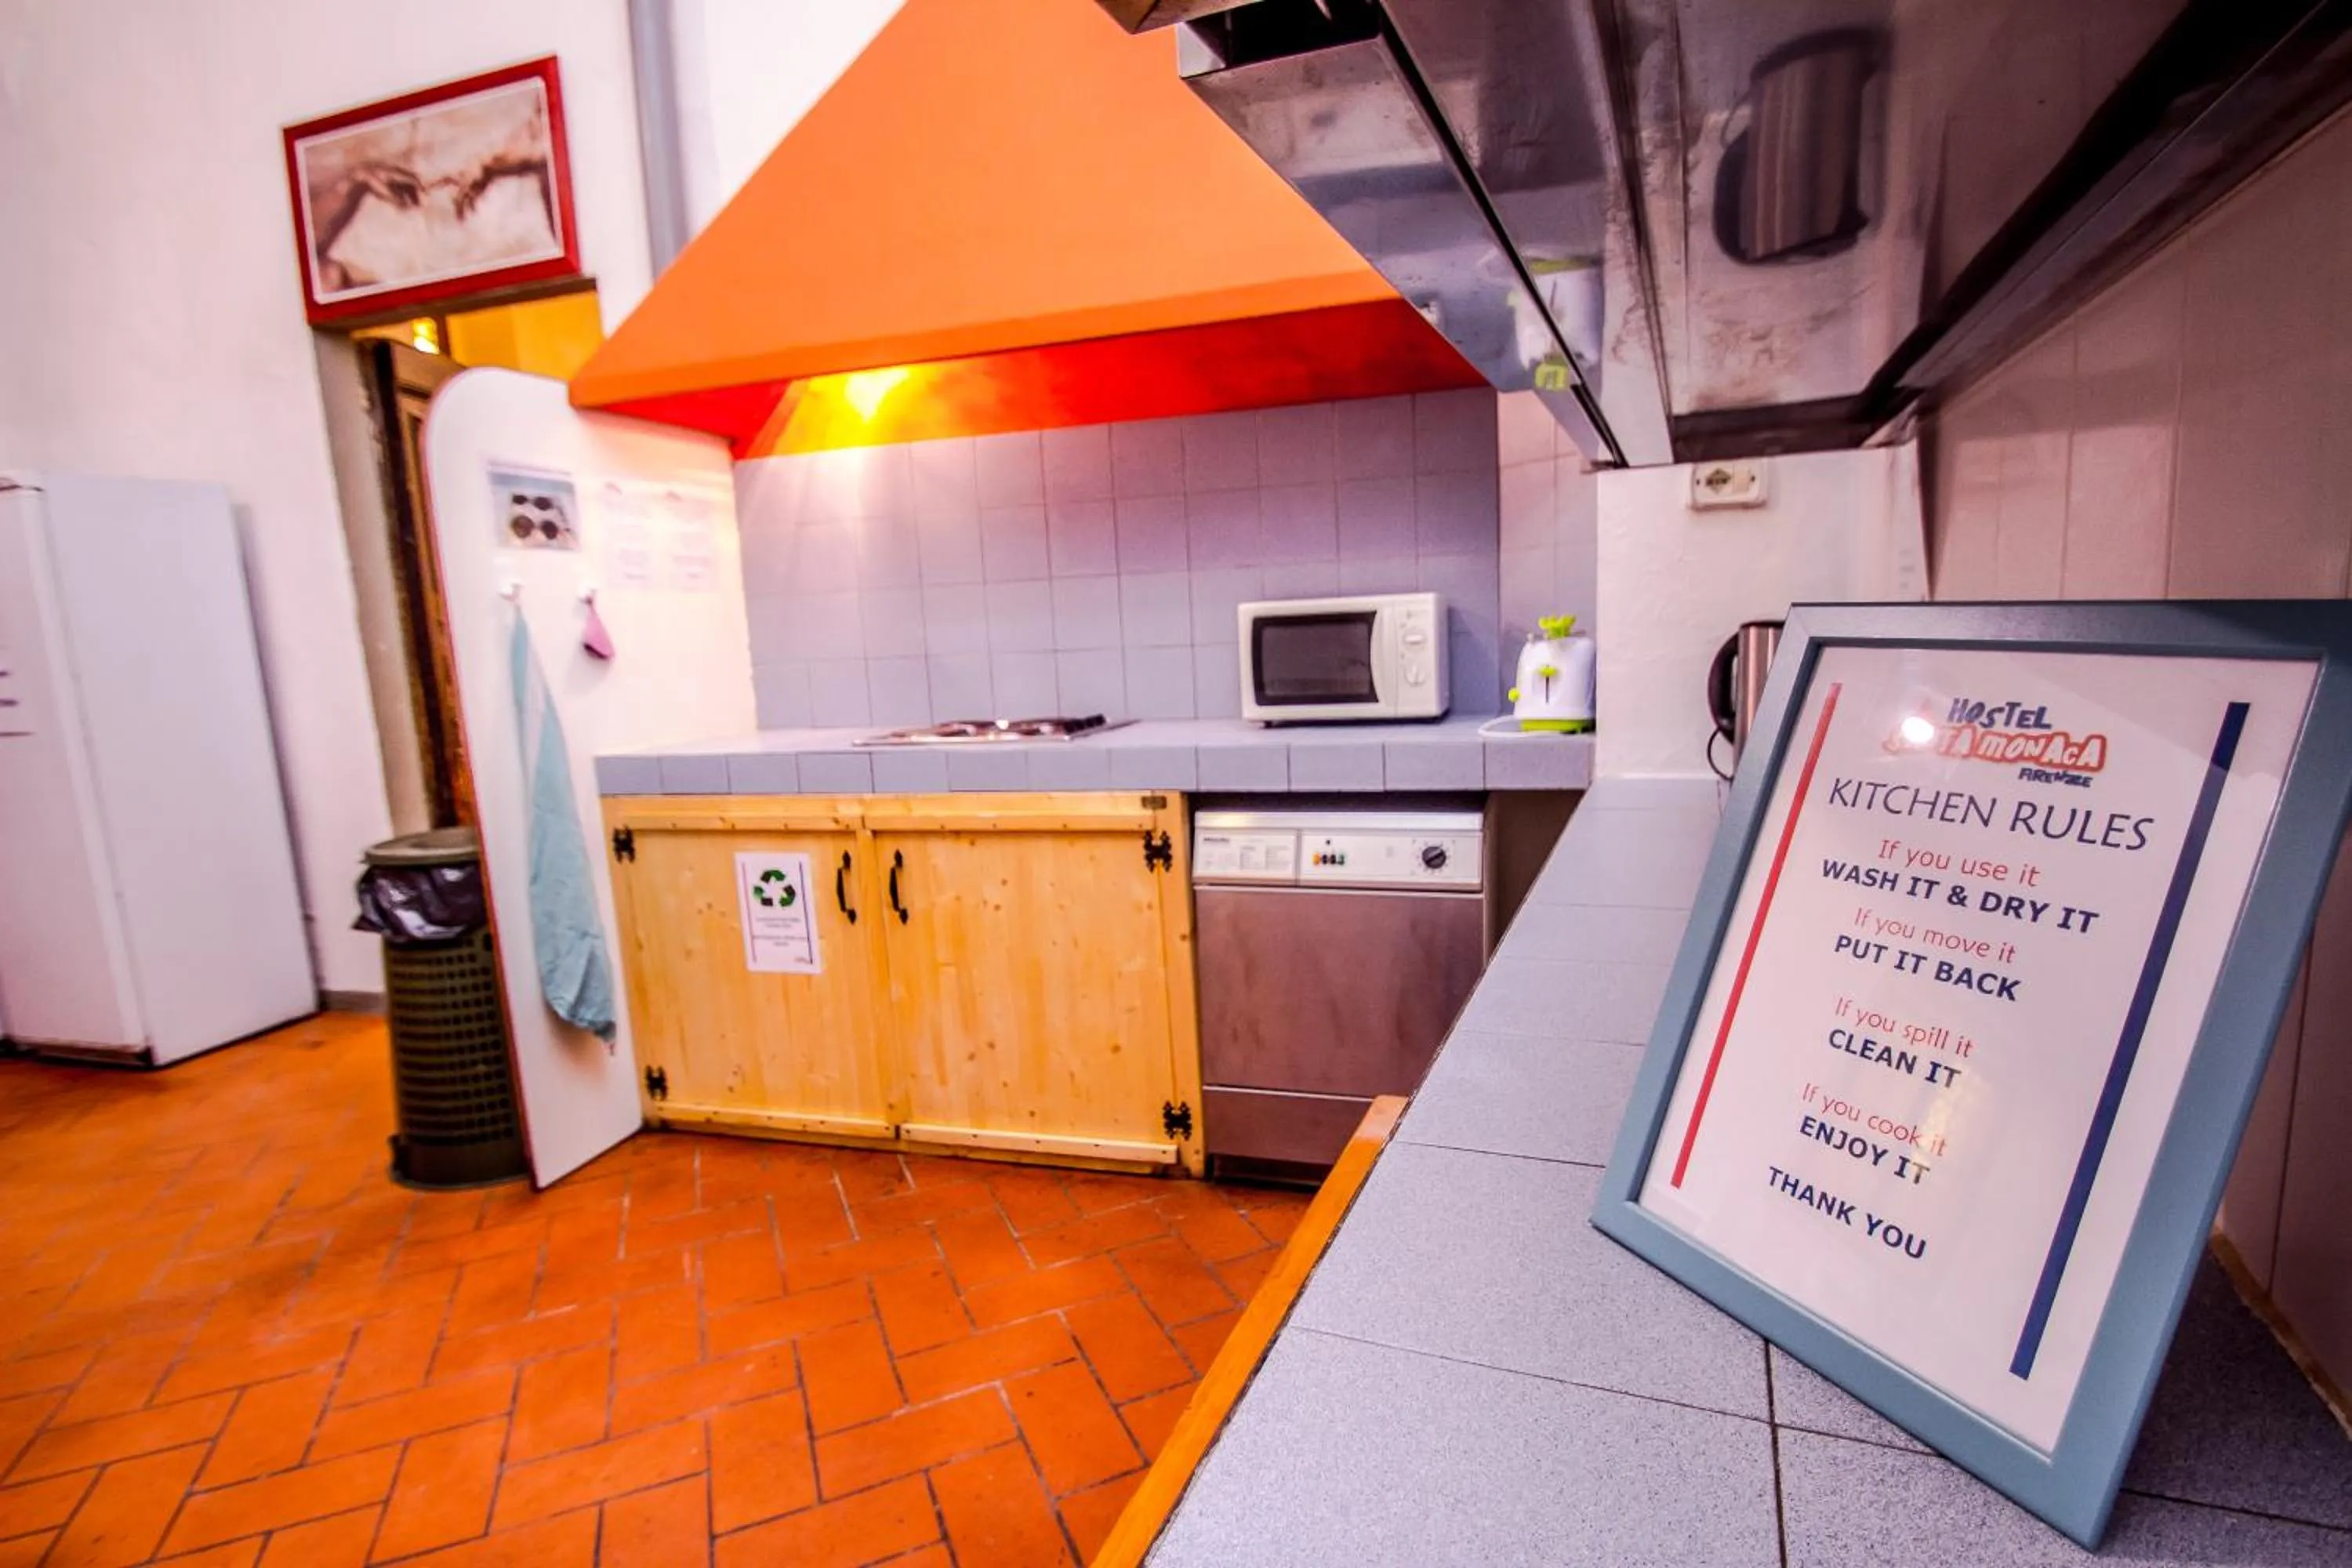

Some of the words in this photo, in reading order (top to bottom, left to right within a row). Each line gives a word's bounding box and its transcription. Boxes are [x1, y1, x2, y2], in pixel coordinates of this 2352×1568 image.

[1947, 698, 2053, 729] HOSTEL
[1882, 723, 1977, 758] STA
[1976, 731, 2107, 772] MONACA
[1828, 777, 1998, 829] KITCHEN
[2009, 800, 2154, 851] RULES
[1878, 840, 1901, 859] If
[1905, 848, 1951, 870] you
[1960, 857, 2008, 880] use
[2019, 863, 2041, 887] it
[1821, 858, 1900, 892] WASH
[1906, 876, 1940, 899] IT
[1947, 885, 1969, 907] &
[1979, 891, 2050, 923] DRY
[2056, 906, 2100, 934] IT
[1854, 907, 1873, 927] If
[1875, 917, 1916, 940] you
[1922, 927, 1991, 957] move
[1998, 942, 2017, 964] it
[1834, 935, 1889, 964] PUT
[1893, 949, 1928, 975] IT
[1933, 960, 2022, 1002] BACK
[1828, 1029, 1918, 1075] CLEAN
[1925, 1061, 1962, 1089] IT
[1835, 997, 1853, 1017] If
[1855, 1008, 1896, 1033] you
[1901, 1022, 1950, 1051] spill
[1955, 1036, 1973, 1058] it
[1799, 1115, 1889, 1167] ENJOY
[1893, 1155, 1930, 1185] IT
[1802, 1083, 1820, 1102] If
[1821, 1095, 1860, 1123] you
[1867, 1115, 1922, 1148] cook
[1929, 1134, 1947, 1157] it
[1769, 1166, 1857, 1225] THANK
[1865, 1213, 1926, 1259] YOU
